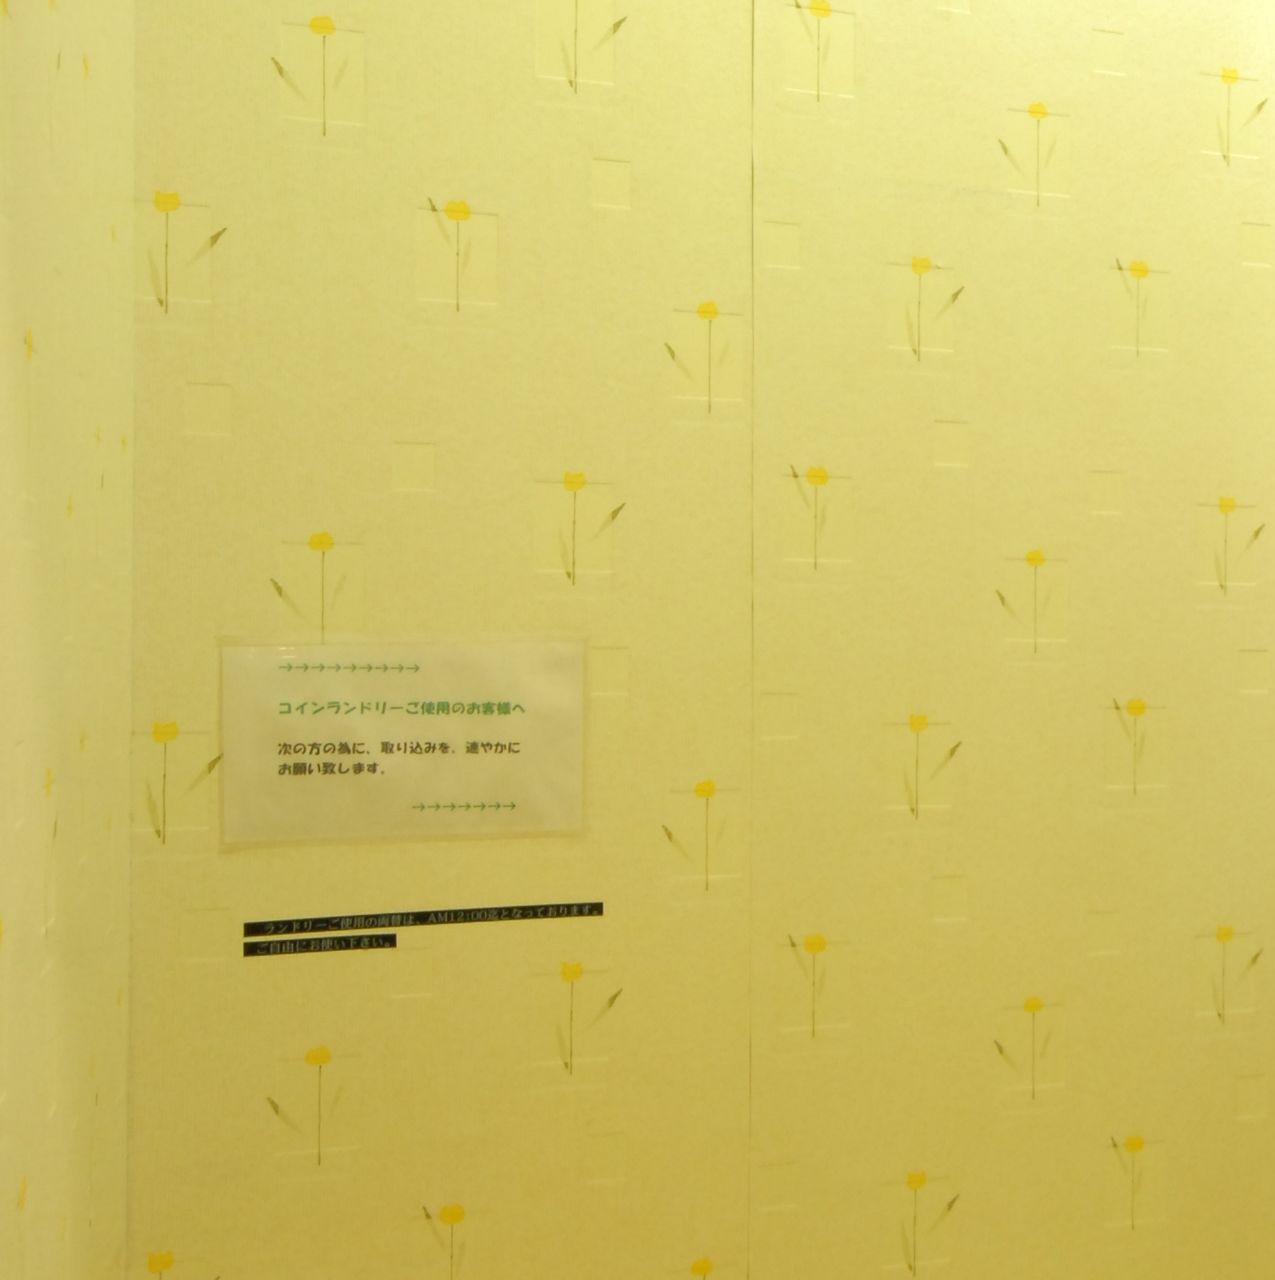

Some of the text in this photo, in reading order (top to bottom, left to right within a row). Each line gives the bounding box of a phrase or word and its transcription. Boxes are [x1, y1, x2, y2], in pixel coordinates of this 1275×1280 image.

[278, 700, 526, 716] コインランドリーご使用のお客様へ
[277, 761, 386, 777] お願い致します。
